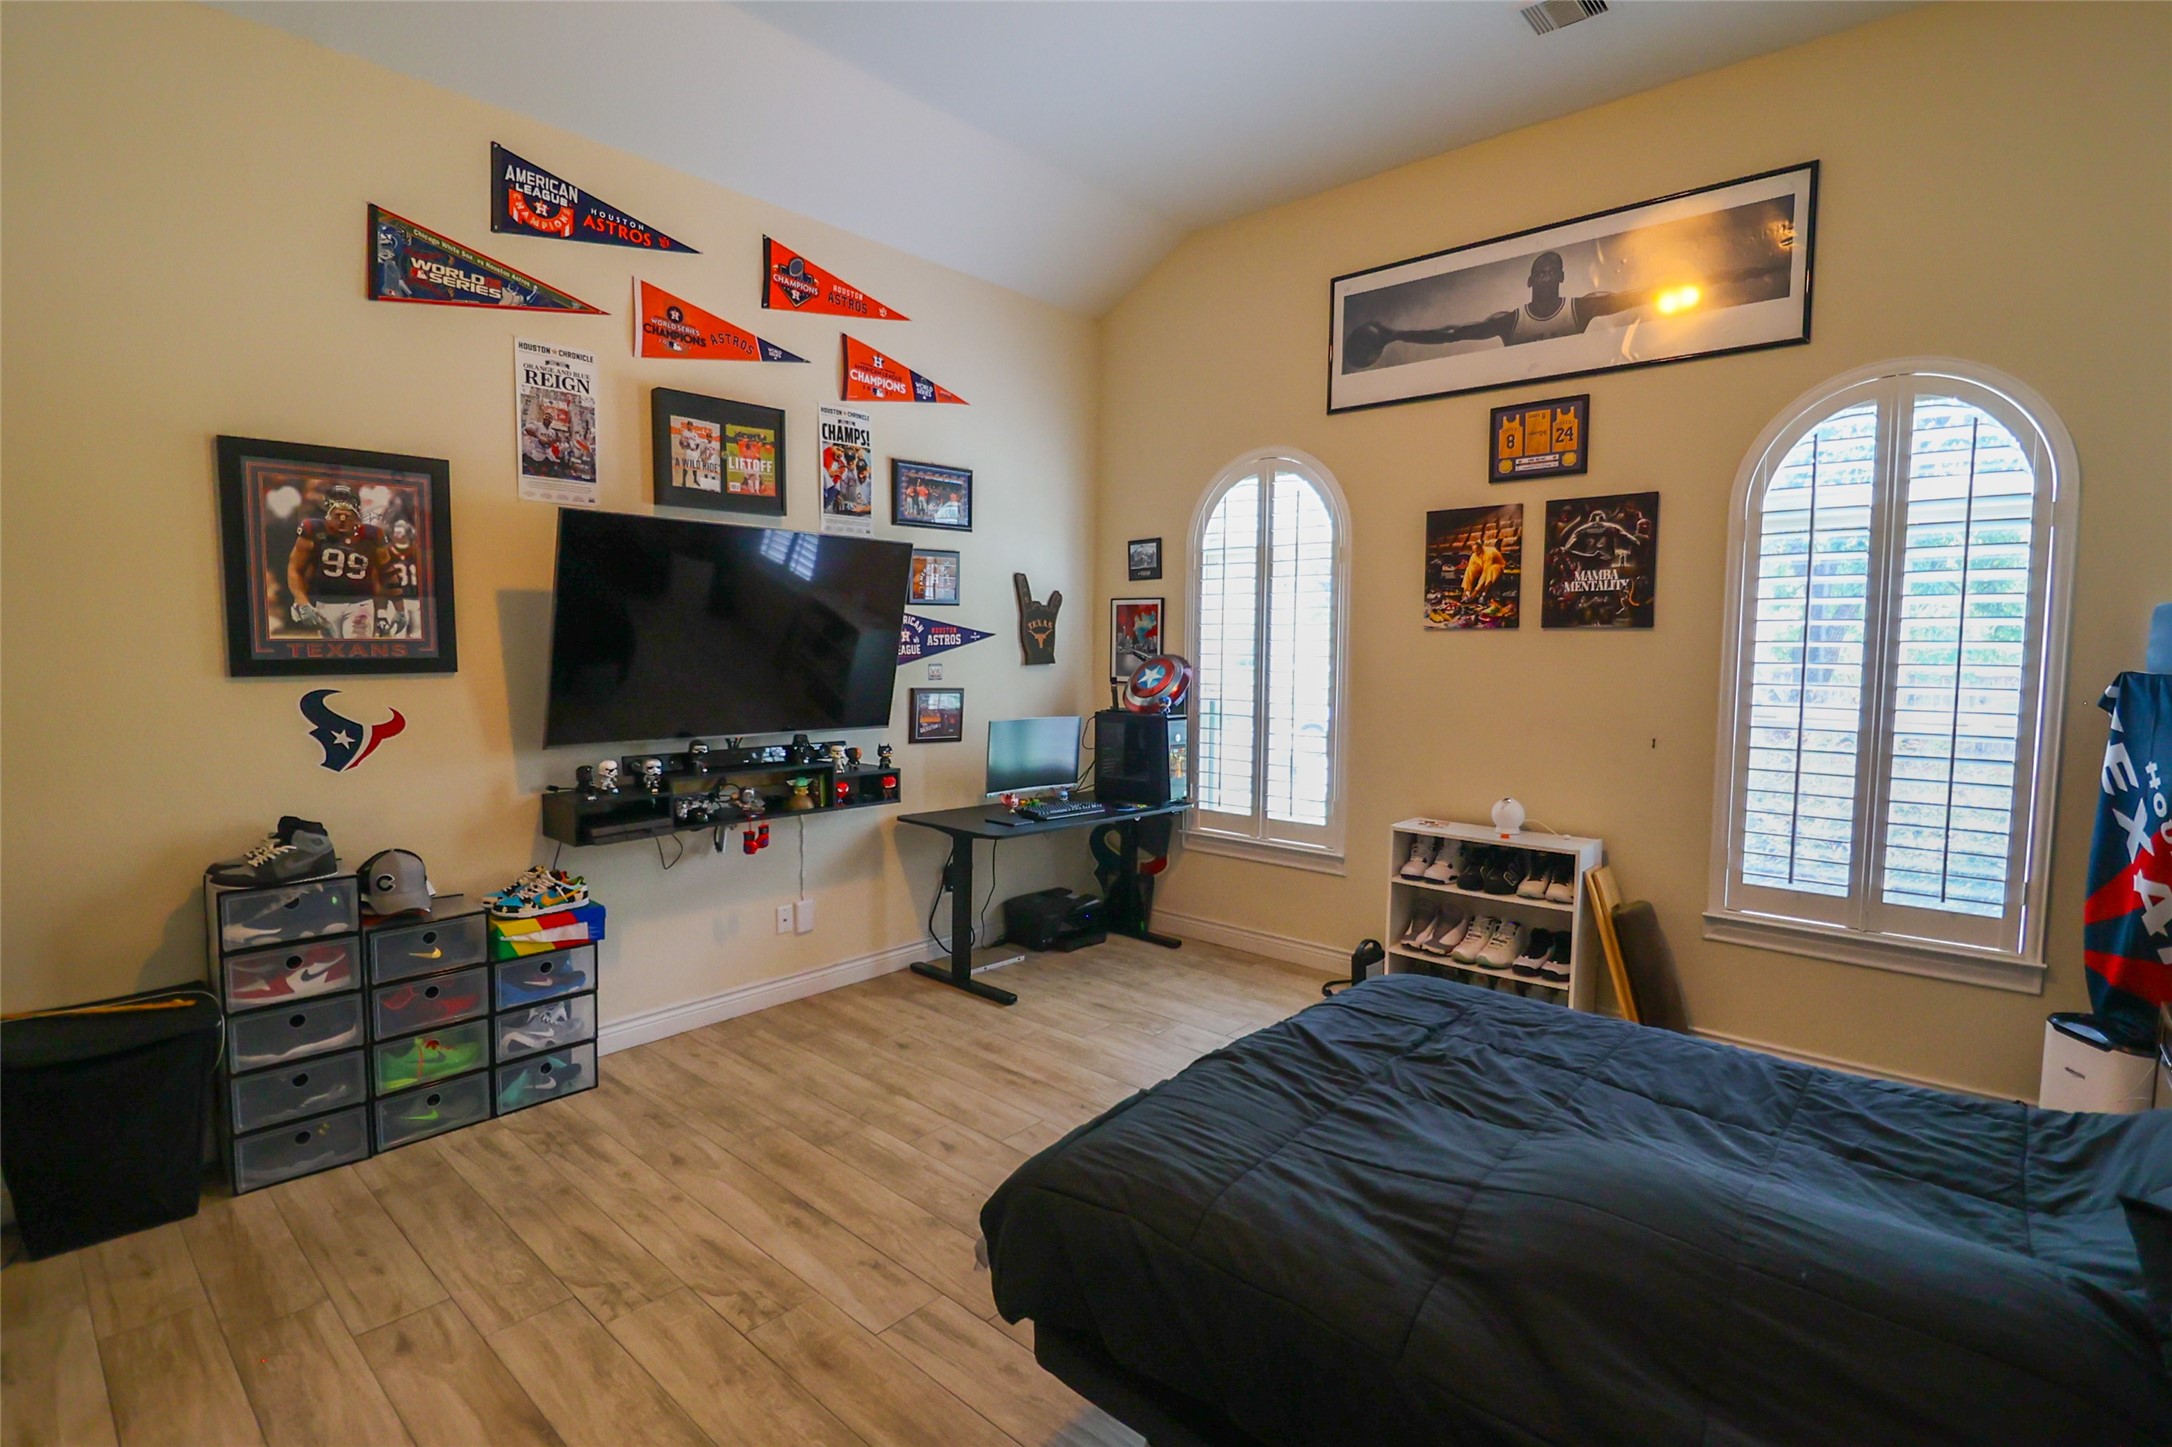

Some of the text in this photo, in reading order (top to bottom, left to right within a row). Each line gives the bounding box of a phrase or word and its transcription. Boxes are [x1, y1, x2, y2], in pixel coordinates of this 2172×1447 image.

[505, 164, 578, 204] AMERICAN
[515, 183, 568, 207] LEAGUE
[512, 193, 571, 231] CHAMPIONS
[591, 208, 645, 231] HOUSTON
[583, 214, 652, 247] ASTROS
[413, 229, 440, 245] Chicago
[441, 240, 460, 254] White
[462, 250, 473, 260] Sox
[486, 261, 511, 277] Houston
[411, 257, 485, 285] WORLD
[429, 272, 502, 300] SERIES
[773, 274, 819, 296] CHAMPIONS
[833, 285, 863, 300] HOUSTON
[828, 292, 868, 314] ASTROS
[643, 323, 707, 347] CHAMPIONS
[650, 317, 700, 337] WORLD SERIES
[518, 341, 594, 363] HOUSTON CHRONICLE
[710, 333, 755, 355] ASTROS
[523, 363, 555, 374] ORANGE
[573, 372, 591, 380] BLUE
[524, 369, 590, 395] REIGN
[850, 369, 907, 394] CHAMPIONS
[915, 382, 933, 392] WORLD
[820, 407, 870, 421] HOUSTON CHRONICLE
[822, 423, 870, 447] CHAMPS!
[1506, 434, 1515, 449] 8
[1555, 426, 1574, 443] 24
[682, 457, 700, 470] WILD
[728, 456, 773, 473] LIFTOFF
[322, 548, 369, 579] 99
[1564, 579, 1630, 592] MENTALITY
[1574, 569, 1619, 581] MAMBA
[903, 615, 925, 633] RICAN
[1028, 619, 1052, 630] TEXAS
[286, 643, 409, 658] TEXANS
[898, 644, 921, 655] EAGUE
[927, 634, 961, 646] ASTROS
[376, 874, 396, 892] C
